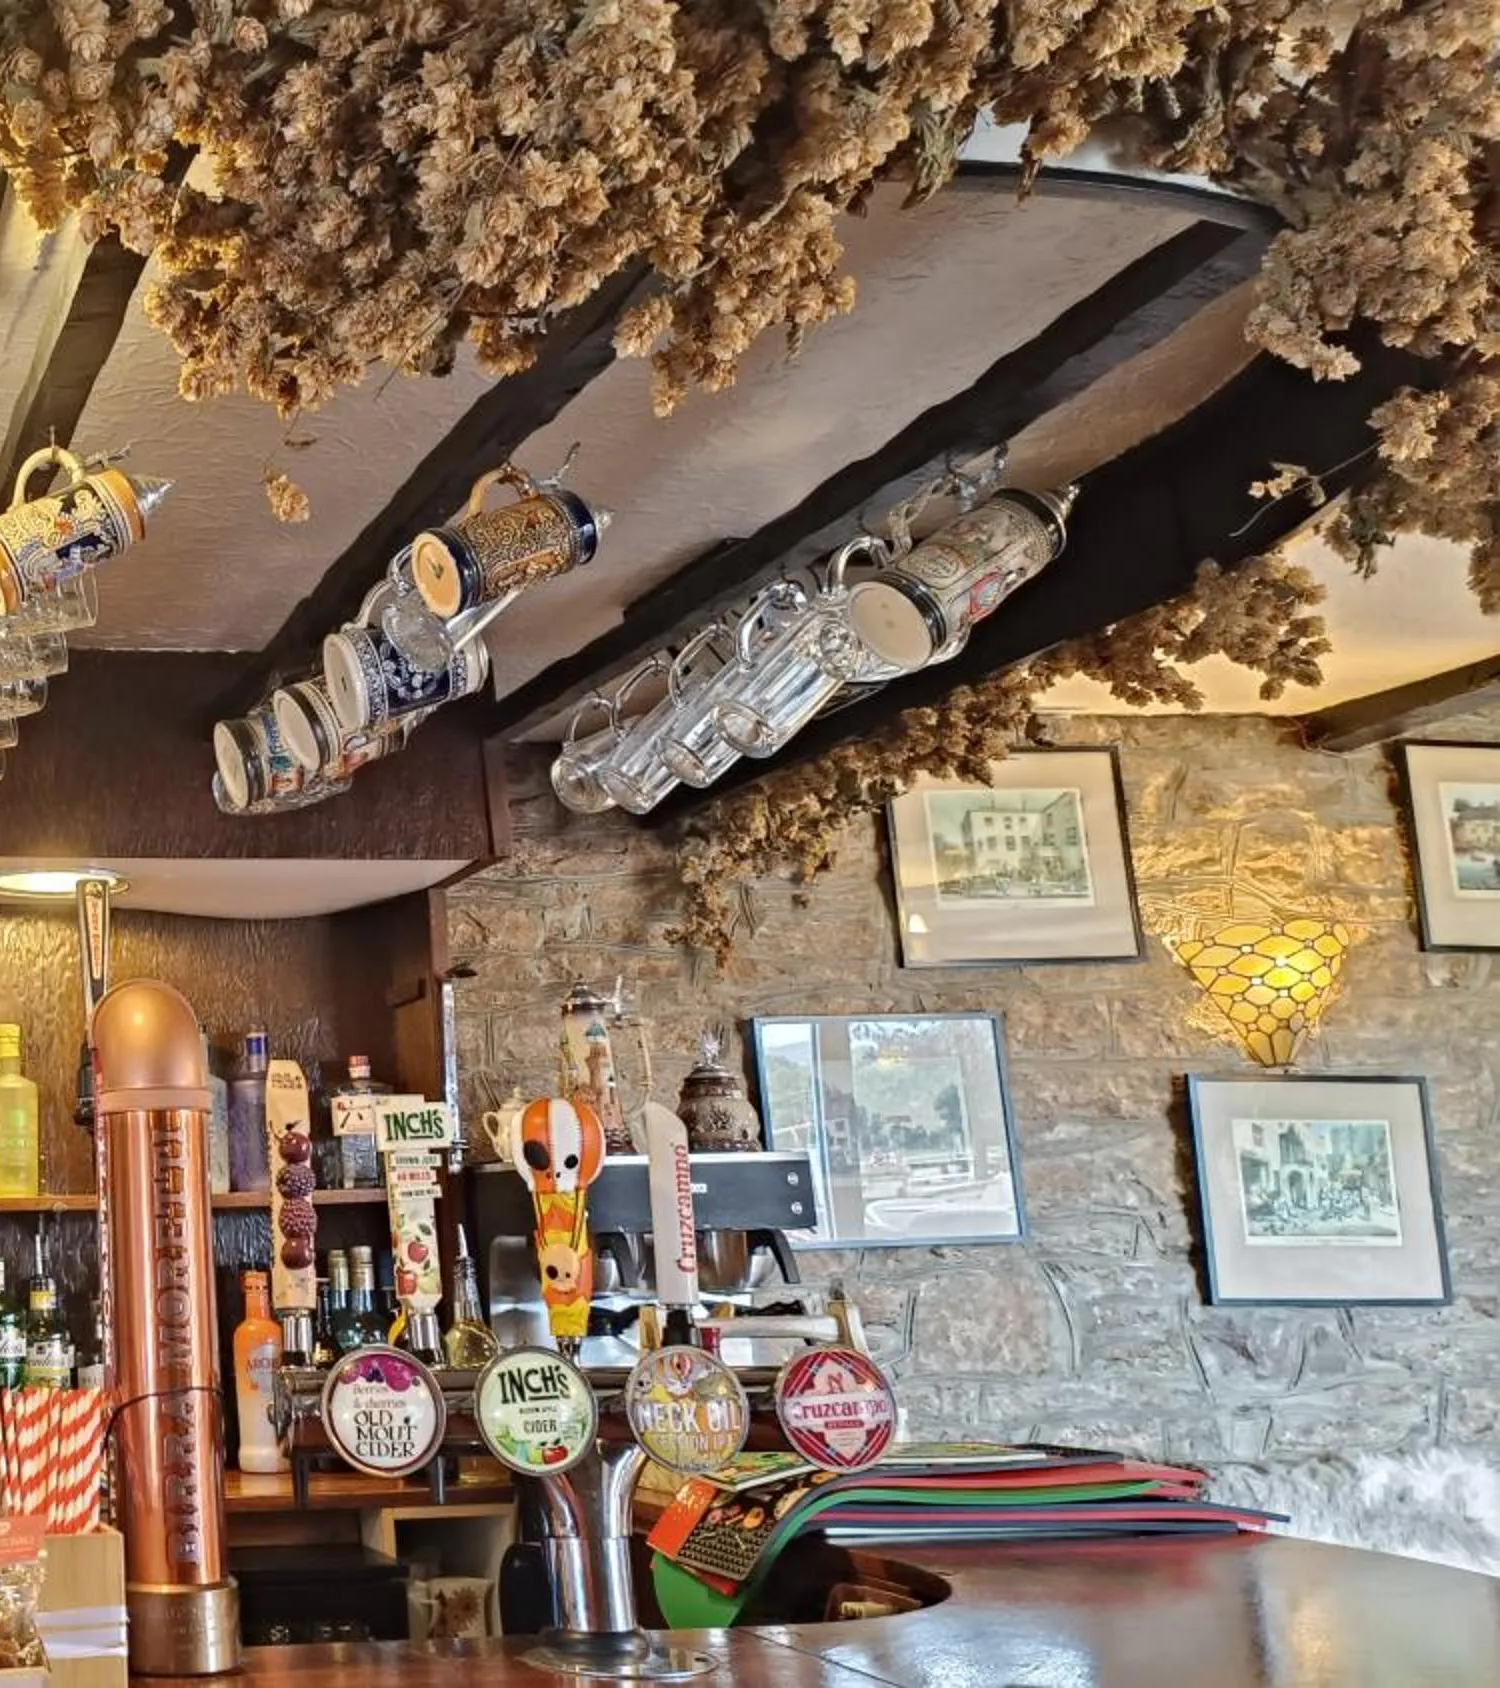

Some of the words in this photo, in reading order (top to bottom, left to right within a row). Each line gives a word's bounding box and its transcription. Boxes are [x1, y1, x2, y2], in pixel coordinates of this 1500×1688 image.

[384, 1109, 445, 1142] INCH'S
[675, 1143, 697, 1274] Cruzcampo
[150, 1122, 194, 1370] MORETTI
[498, 1365, 571, 1405] INCH'S
[354, 1409, 393, 1426] OLD
[356, 1425, 418, 1440] MOUT
[523, 1418, 557, 1434] CIDER
[634, 1401, 701, 1433] NECK
[707, 1399, 741, 1433] OIL
[356, 1441, 416, 1457] CIDER
